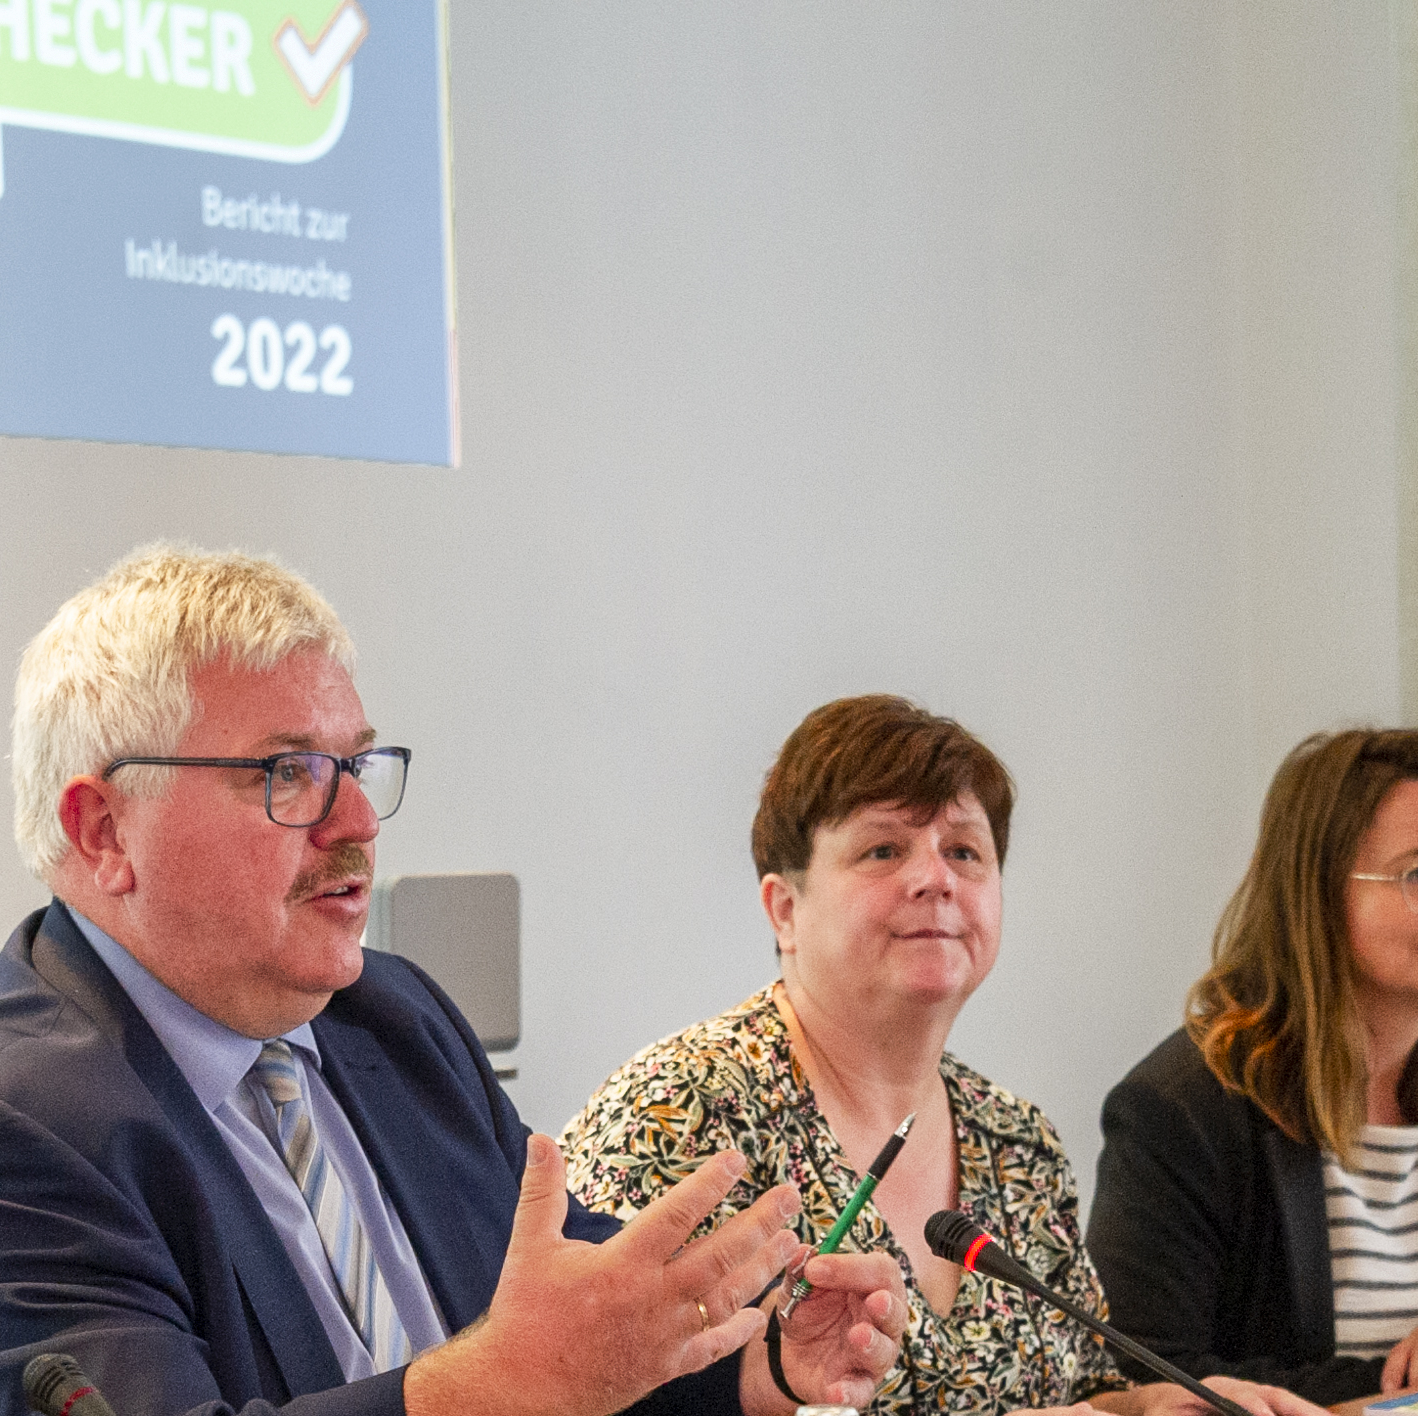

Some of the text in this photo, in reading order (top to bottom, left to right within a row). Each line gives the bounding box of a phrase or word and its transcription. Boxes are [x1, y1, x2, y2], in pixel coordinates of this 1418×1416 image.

[201, 184, 350, 242] Bericht zur
[125, 236, 352, 302] Inklusionswoche
[210, 312, 355, 397] 2022
